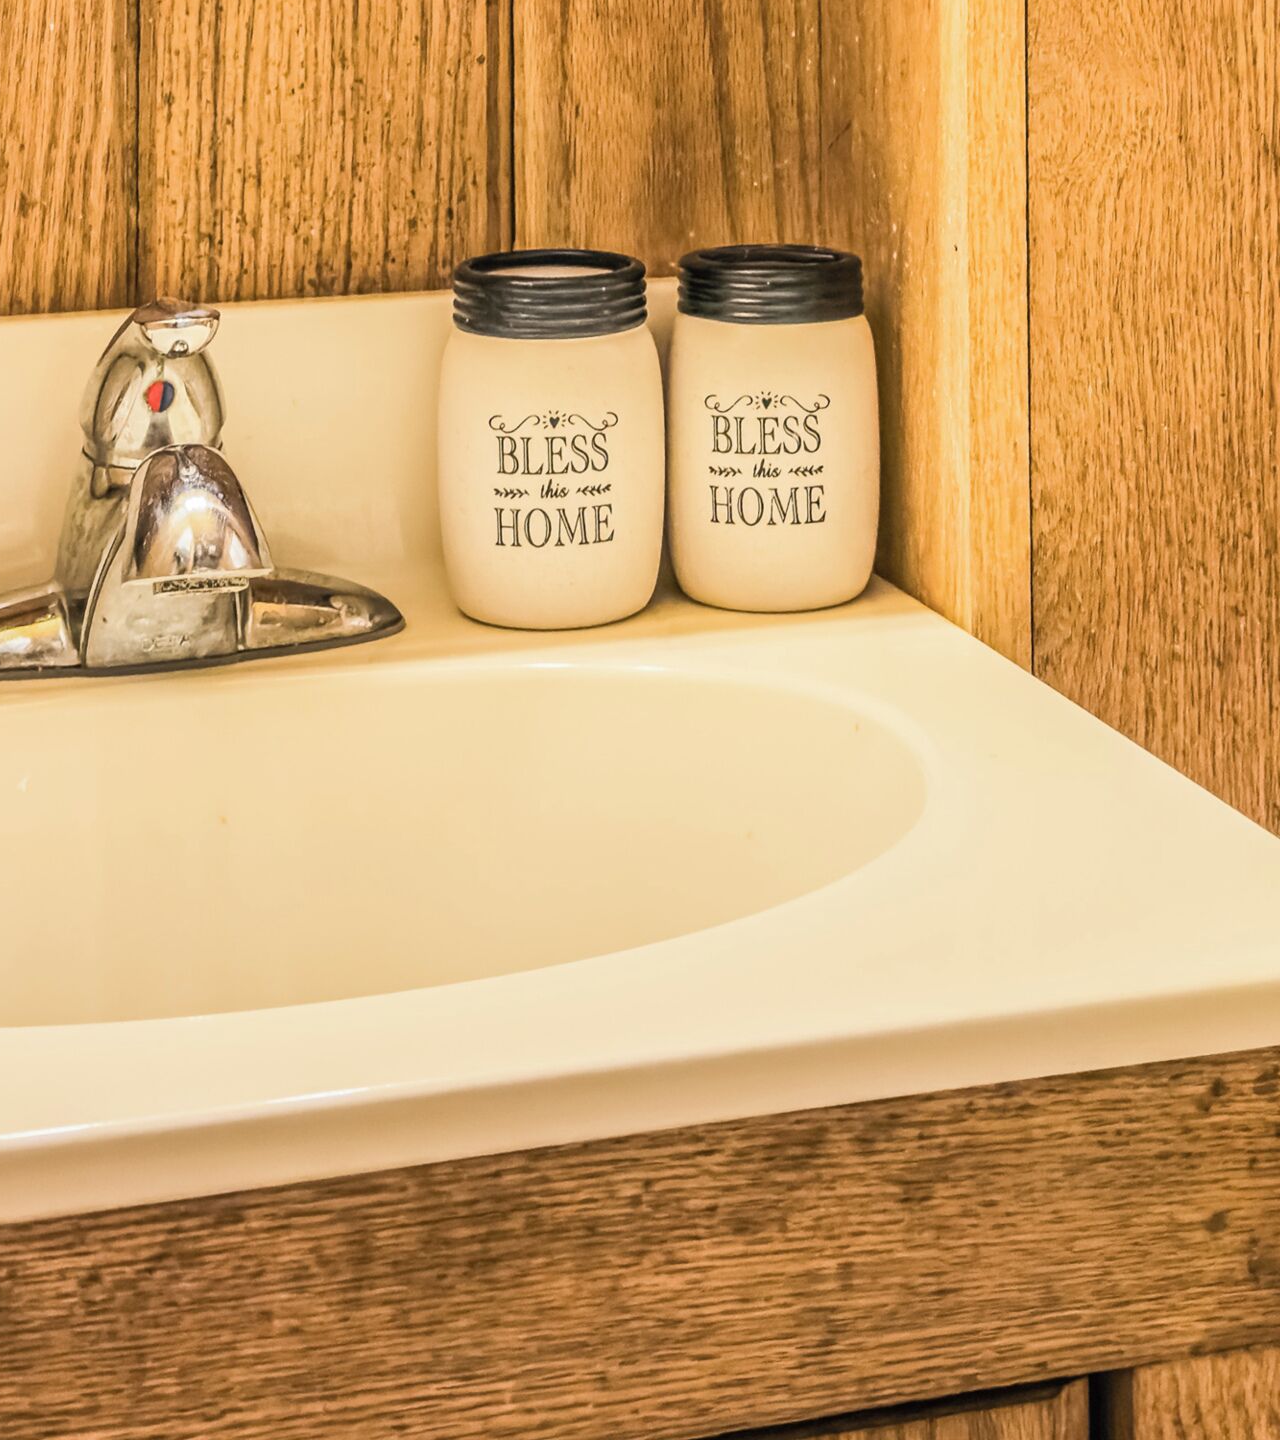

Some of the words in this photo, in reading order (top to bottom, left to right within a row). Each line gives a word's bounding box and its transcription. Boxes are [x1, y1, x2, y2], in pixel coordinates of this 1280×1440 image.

[496, 432, 609, 476] BLESS
[710, 413, 822, 456] BLESS
[540, 478, 570, 499] this
[752, 458, 782, 478] this
[494, 503, 615, 548] HOME
[709, 484, 827, 527] HOME
